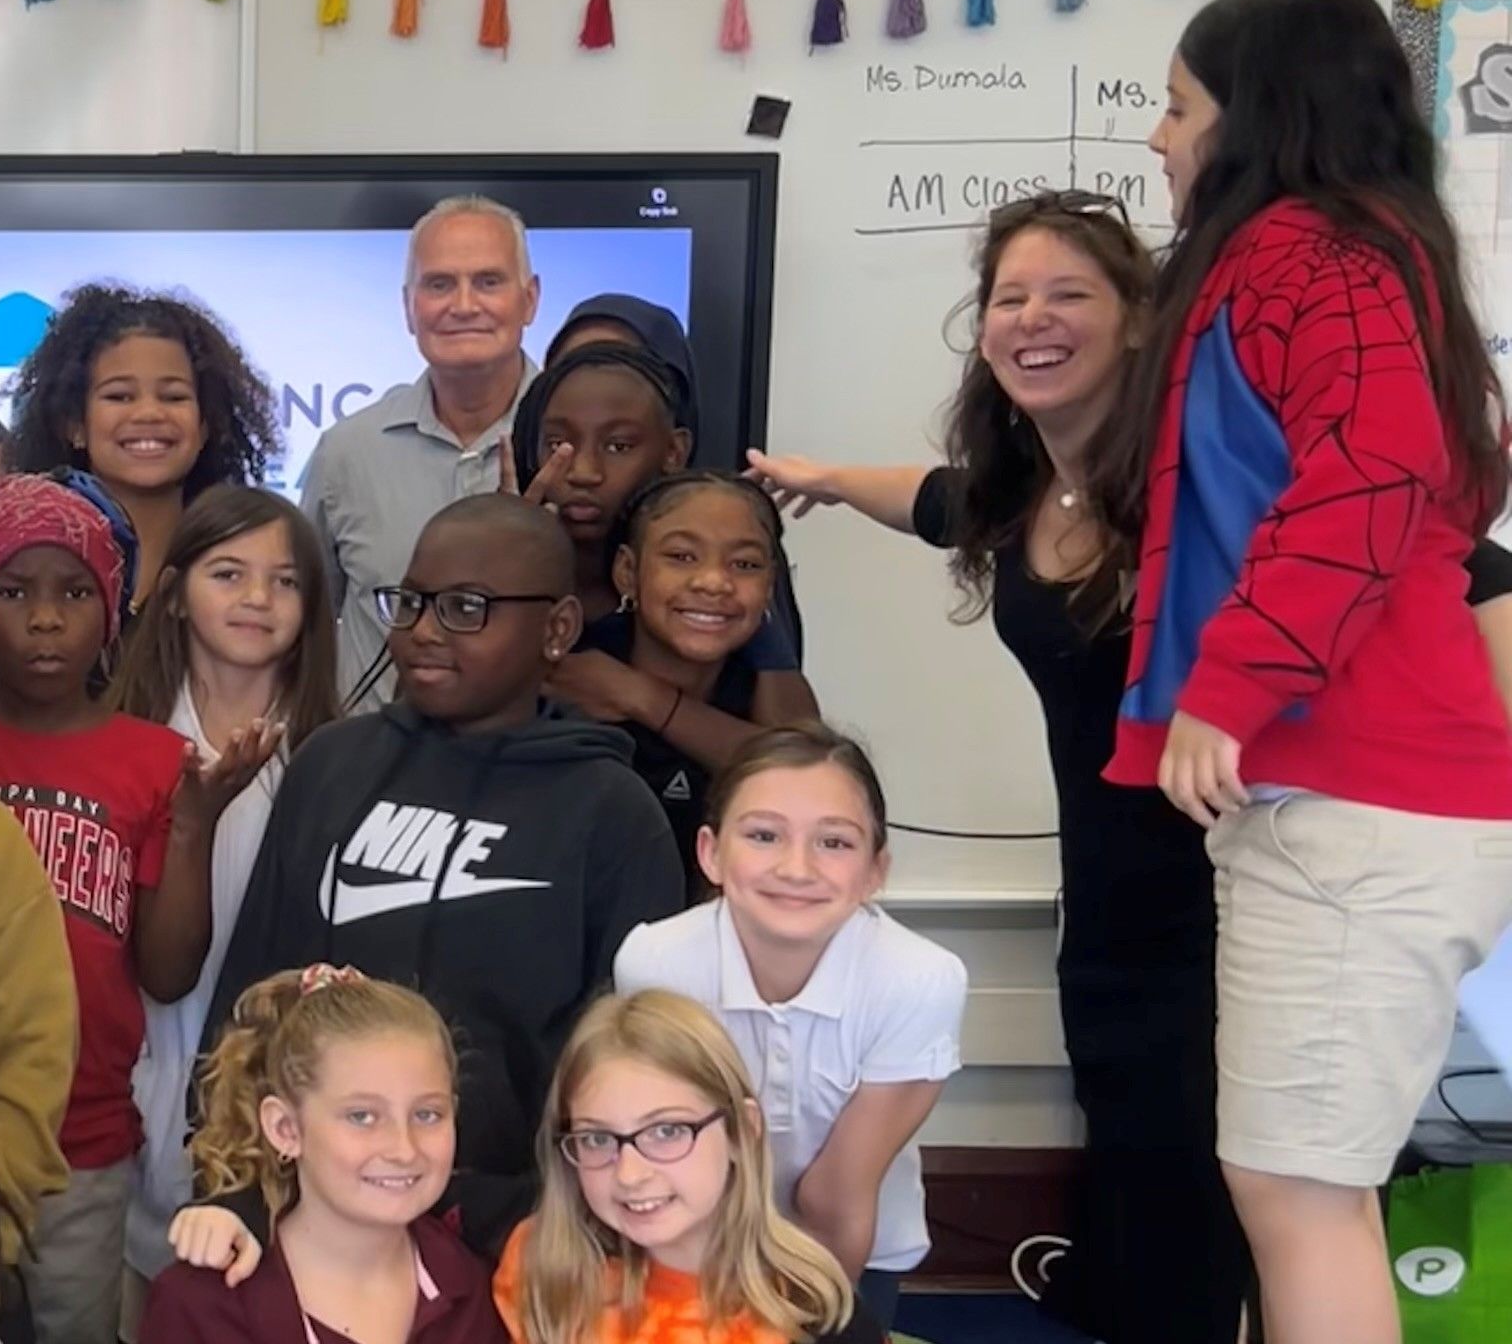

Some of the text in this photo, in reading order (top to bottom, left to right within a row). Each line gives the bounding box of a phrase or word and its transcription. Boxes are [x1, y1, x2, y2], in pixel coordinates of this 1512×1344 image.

[866, 63, 1027, 92] Ms. Dumala
[1097, 80, 1157, 107] Ms.
[888, 173, 1049, 215] AM Class
[1095, 171, 1146, 207] PM
[56, 787, 99, 816] BAY
[340, 800, 509, 889] NIKE
